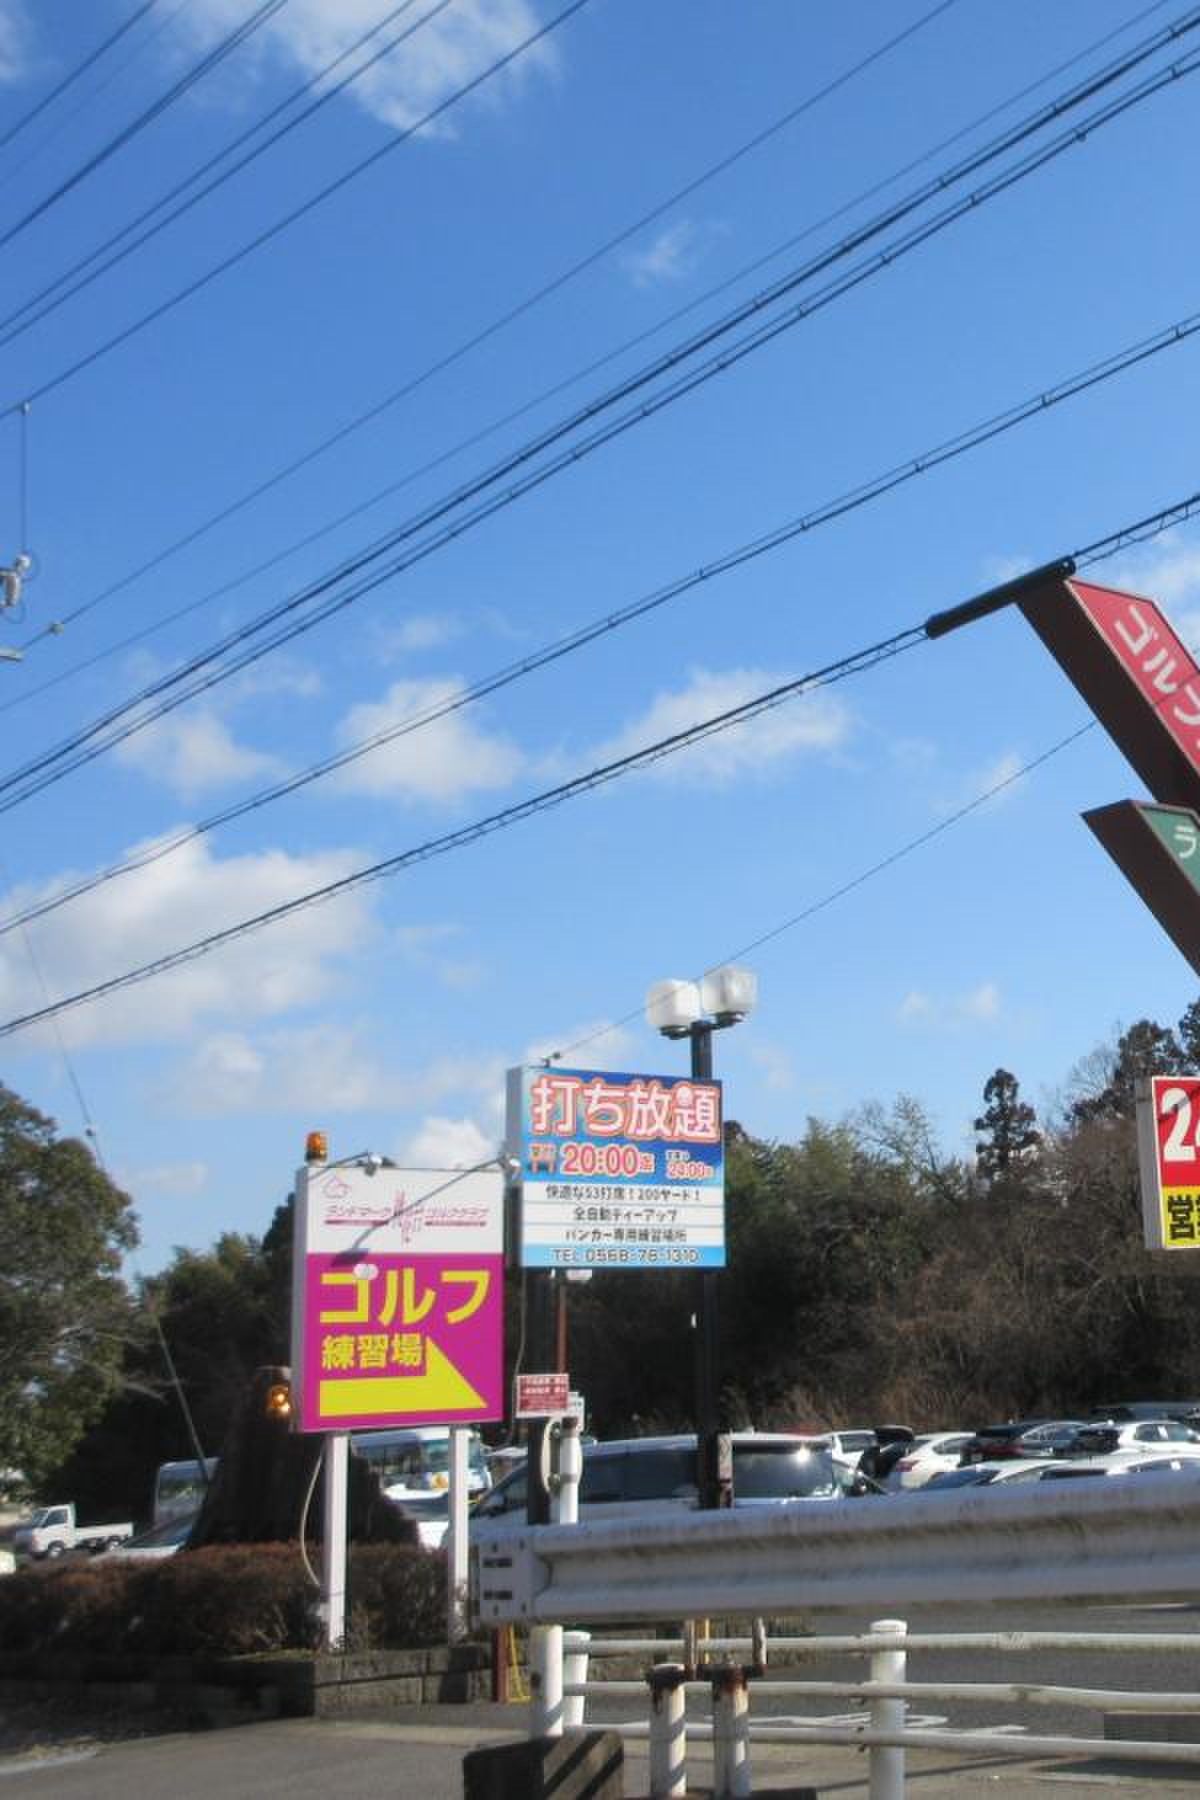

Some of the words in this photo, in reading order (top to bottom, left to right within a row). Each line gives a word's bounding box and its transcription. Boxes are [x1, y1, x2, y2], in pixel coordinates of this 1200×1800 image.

[532, 1076, 720, 1143] 打ち放題
[553, 1249, 577, 1263] TEL
[319, 1268, 489, 1326] ゴルフ
[321, 1332, 423, 1371] 練習場
